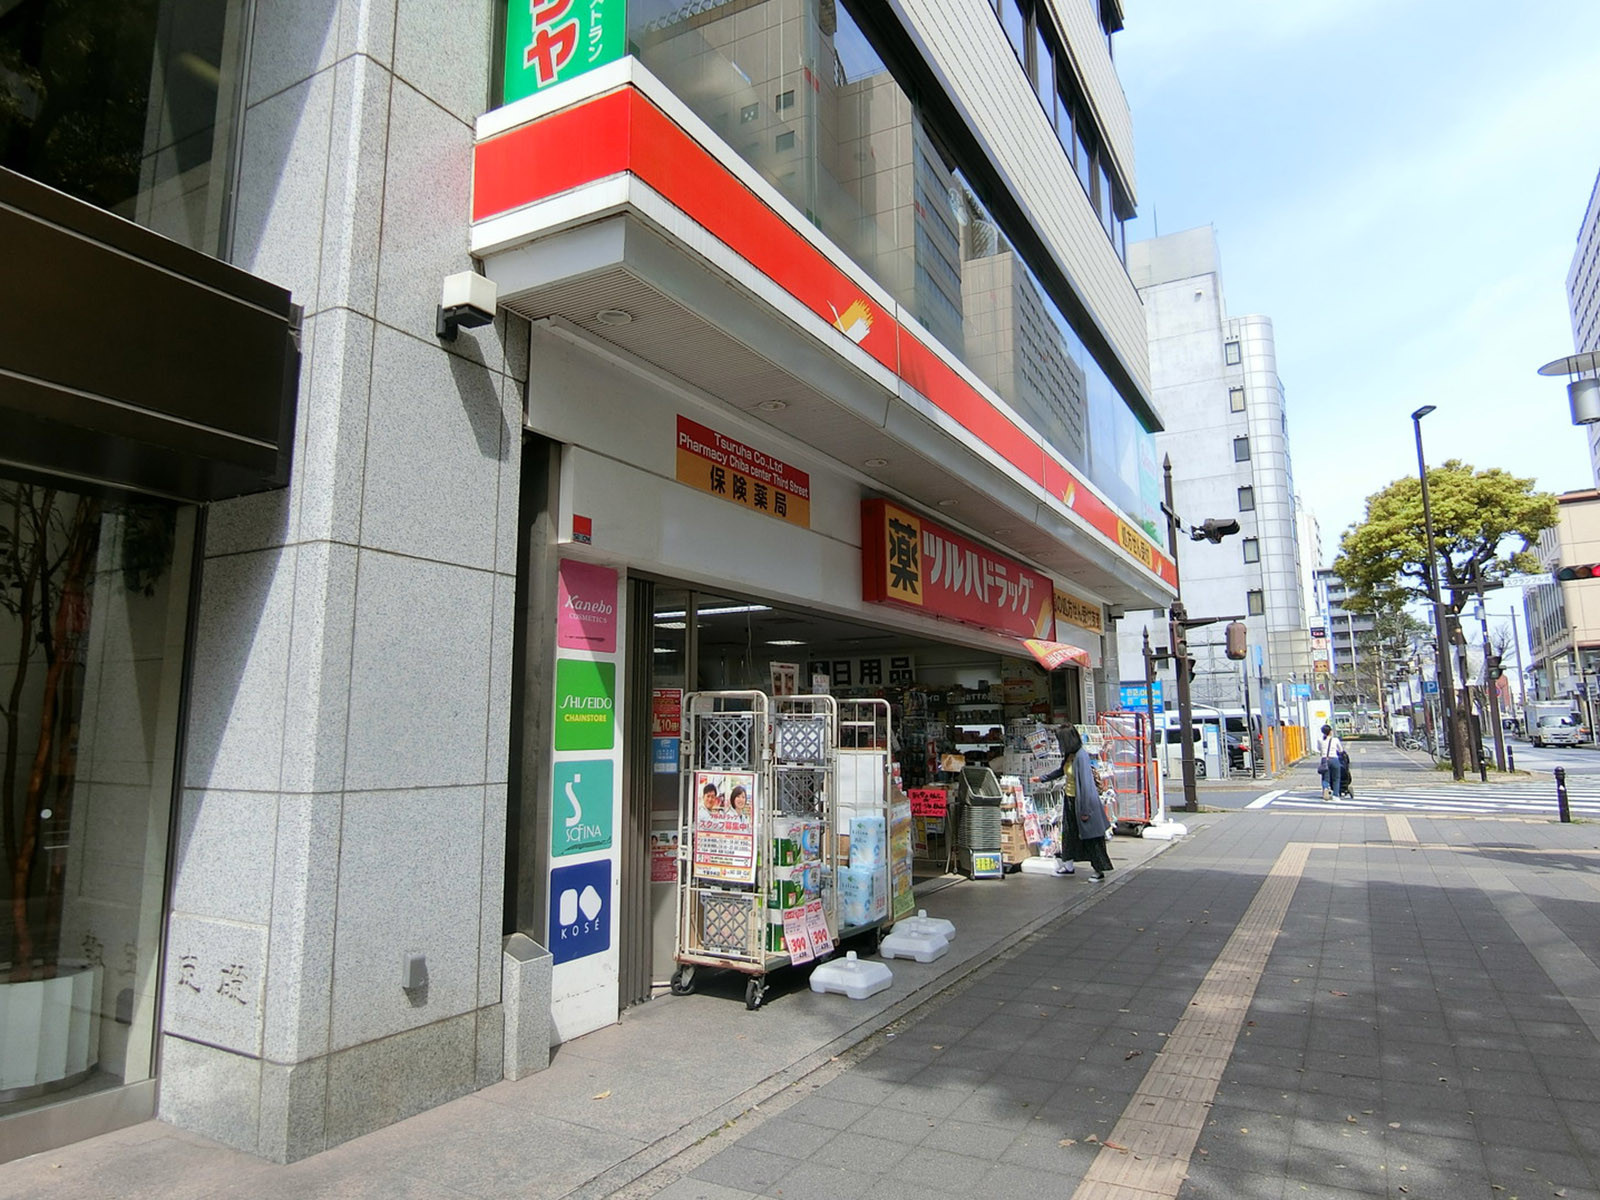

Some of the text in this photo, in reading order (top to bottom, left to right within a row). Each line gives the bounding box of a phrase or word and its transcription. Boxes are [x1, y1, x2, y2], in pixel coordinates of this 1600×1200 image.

[714, 433, 752, 460] Tsuruha
[679, 432, 809, 499] Pharmacy Chiba center Third Street
[710, 464, 787, 517] 保険薬局
[889, 517, 919, 595] 薬
[922, 529, 1034, 616] ツルハドラッグ
[564, 594, 613, 614] Kanebo
[568, 613, 607, 623] COSMETICS
[559, 694, 613, 710] SHISEIDO
[564, 713, 607, 723] CHAINSTORE
[566, 822, 602, 842] SOFINA
[561, 917, 600, 940] KOSÉ
[813, 928, 828, 945] 399
[790, 937, 806, 953] 399
